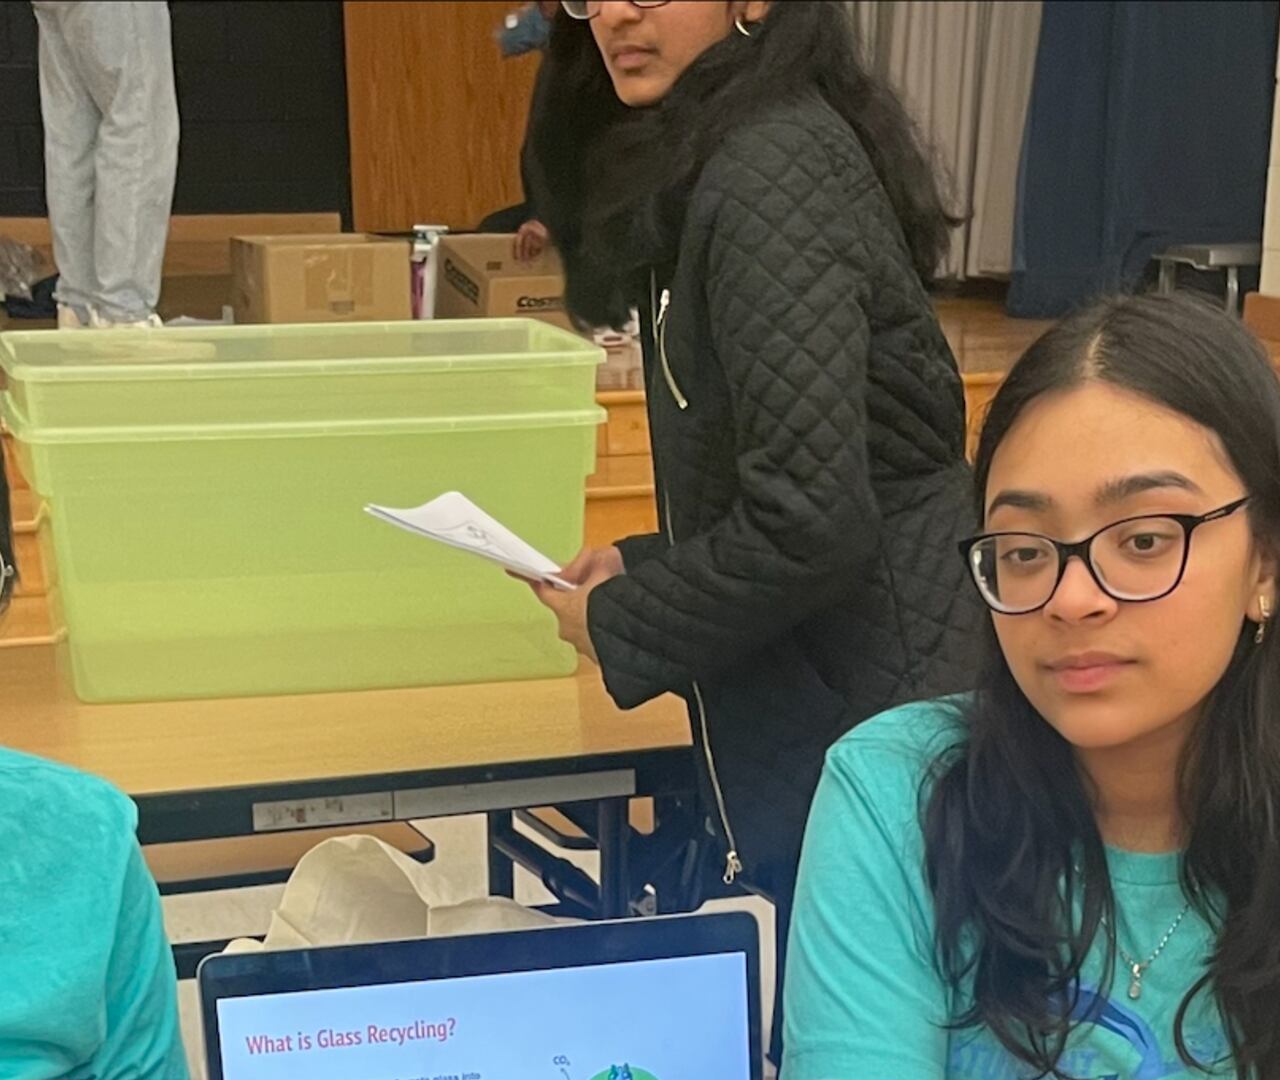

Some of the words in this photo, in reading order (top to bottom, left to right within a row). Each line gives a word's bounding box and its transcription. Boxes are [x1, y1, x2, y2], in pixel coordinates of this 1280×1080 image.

[245, 1034, 293, 1055] What
[297, 1031, 313, 1050] is
[317, 1029, 363, 1049] Glass
[367, 1017, 456, 1046] Recycling?
